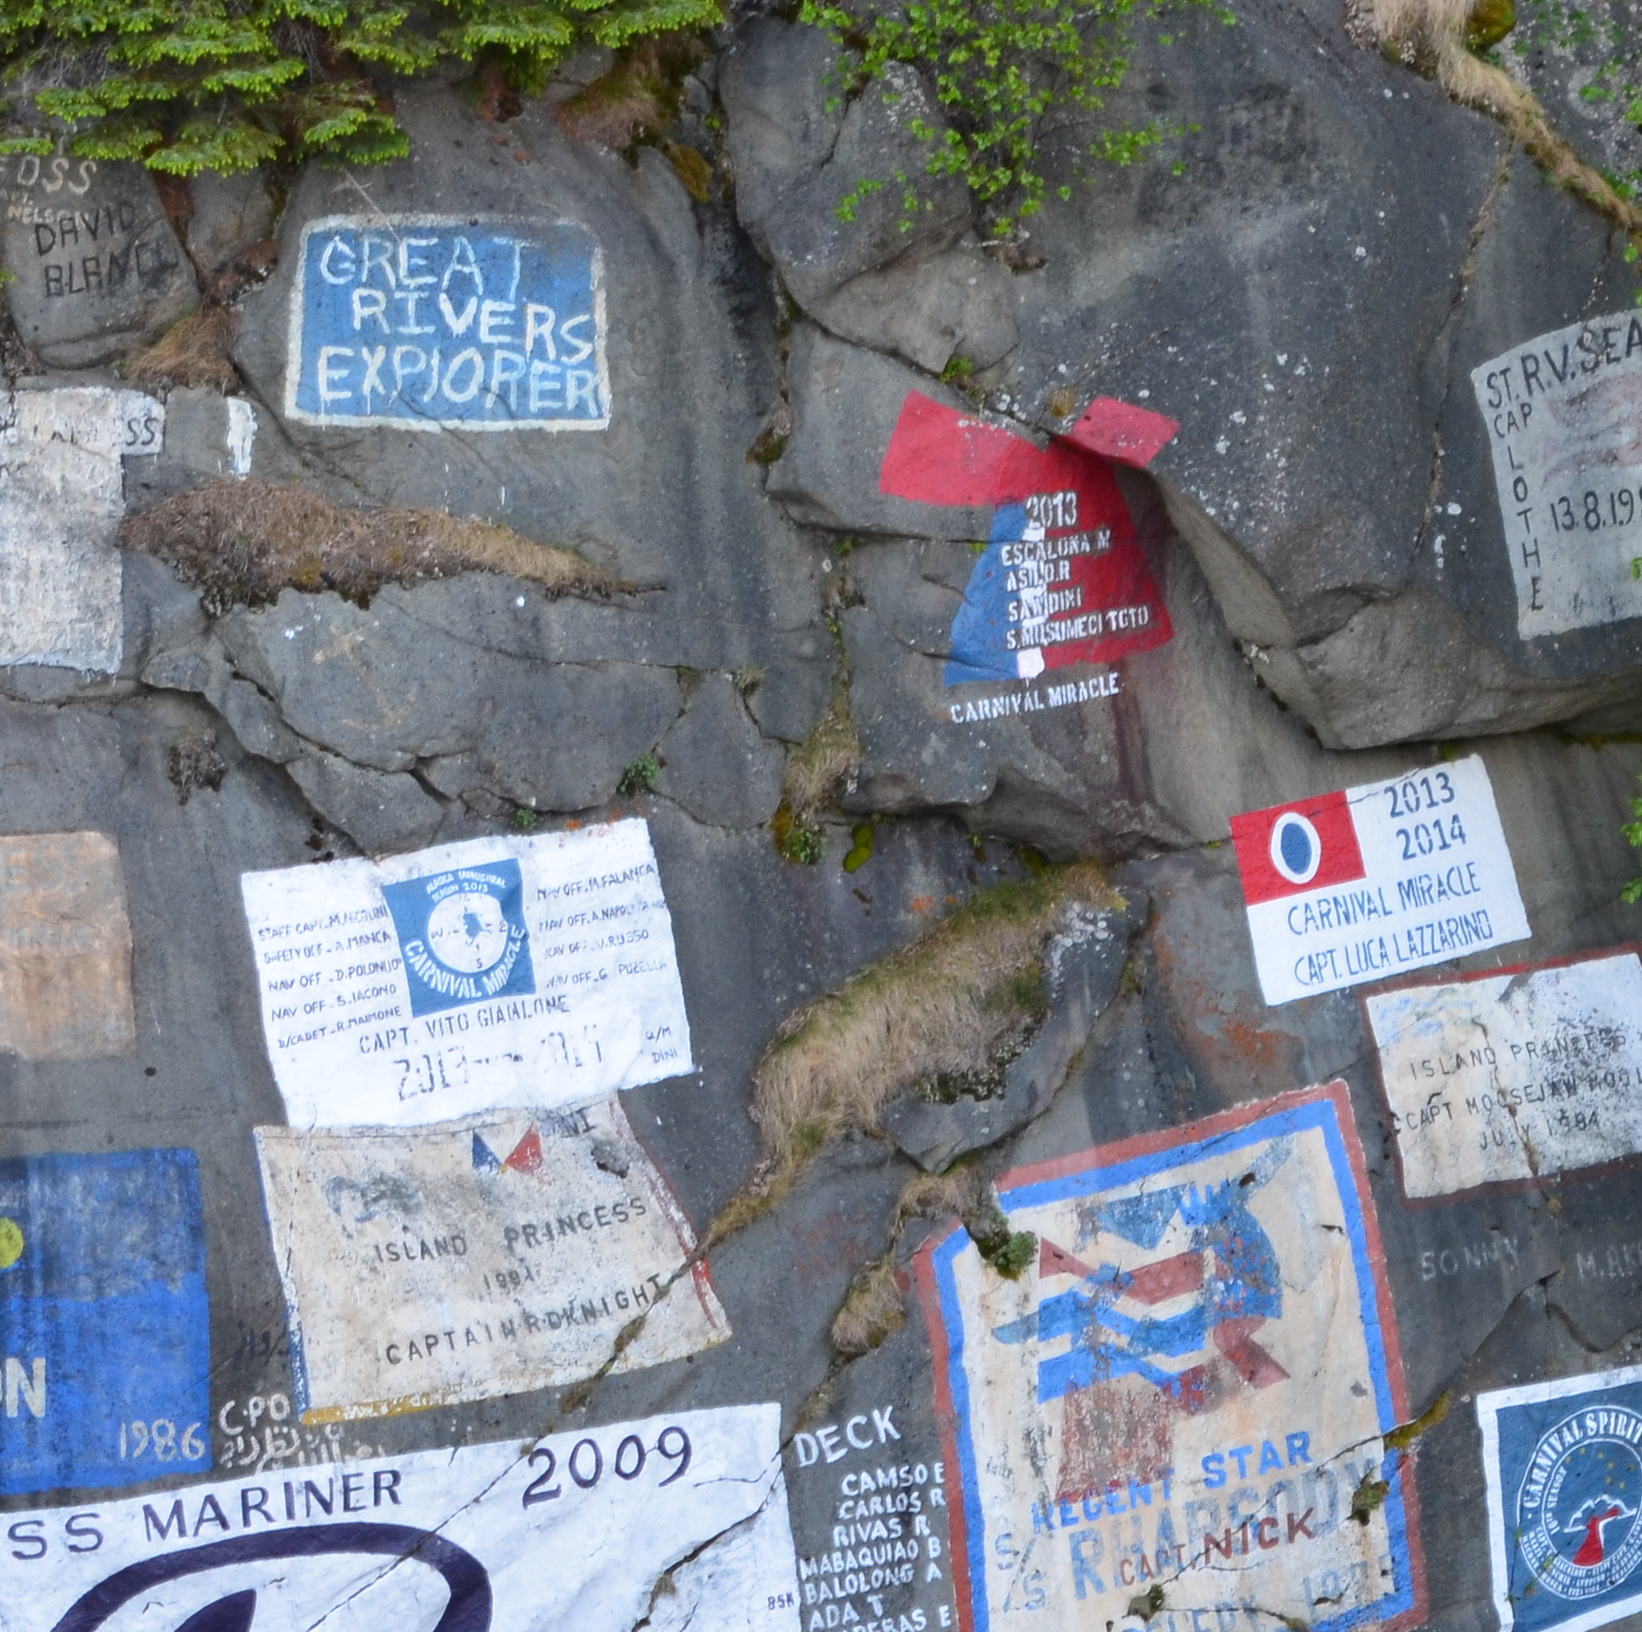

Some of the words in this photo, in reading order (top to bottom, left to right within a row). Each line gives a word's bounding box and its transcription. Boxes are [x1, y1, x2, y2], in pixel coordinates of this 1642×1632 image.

[35, 201, 136, 256] DAVID
[319, 235, 527, 297] GREAT
[353, 288, 595, 362] RIVERS
[1493, 402, 1533, 438] CAP
[1026, 491, 1078, 527] 2013
[951, 690, 1045, 724] CARNIVAL
[1048, 672, 1120, 707] MIRACLE
[1382, 771, 1456, 820] 2013
[1395, 812, 1467, 861] 2014
[463, 882, 488, 893] 2013
[1287, 886, 1395, 937] CARNIVAL
[1397, 861, 1482, 912] MIRACLE
[1346, 934, 1392, 977] LUCA
[1396, 908, 1495, 963] LAZZARINO
[300, 972, 322, 987] OFF
[405, 940, 482, 998] CARNIVAL
[271, 1002, 298, 1022] NAV
[304, 1000, 326, 1015] OFF
[426, 1013, 470, 1039] VITO
[652, 1048, 677, 1063] DINI
[1410, 1047, 1497, 1080] ISLAND
[1407, 1102, 1455, 1131] CAPT
[373, 1234, 468, 1263] ISLAND
[503, 1197, 647, 1253] PRINCESS
[120, 1418, 206, 1461] 1986
[795, 1406, 901, 1468] DECK
[145, 1468, 401, 1541] MARINER
[523, 1425, 693, 1510] 2009
[842, 1465, 928, 1497] CAMSO
[1032, 1468, 1176, 1533] REGENT
[1201, 1431, 1312, 1490] STAR
[1524, 1413, 1584, 1510] CARNIVAL
[839, 1492, 922, 1520] CARLOS
[833, 1519, 902, 1548] RIVAS
[1204, 1508, 1317, 1566] NICK
[799, 1542, 919, 1580] MABAQUIAO
[804, 1567, 914, 1605] BALOLONG
